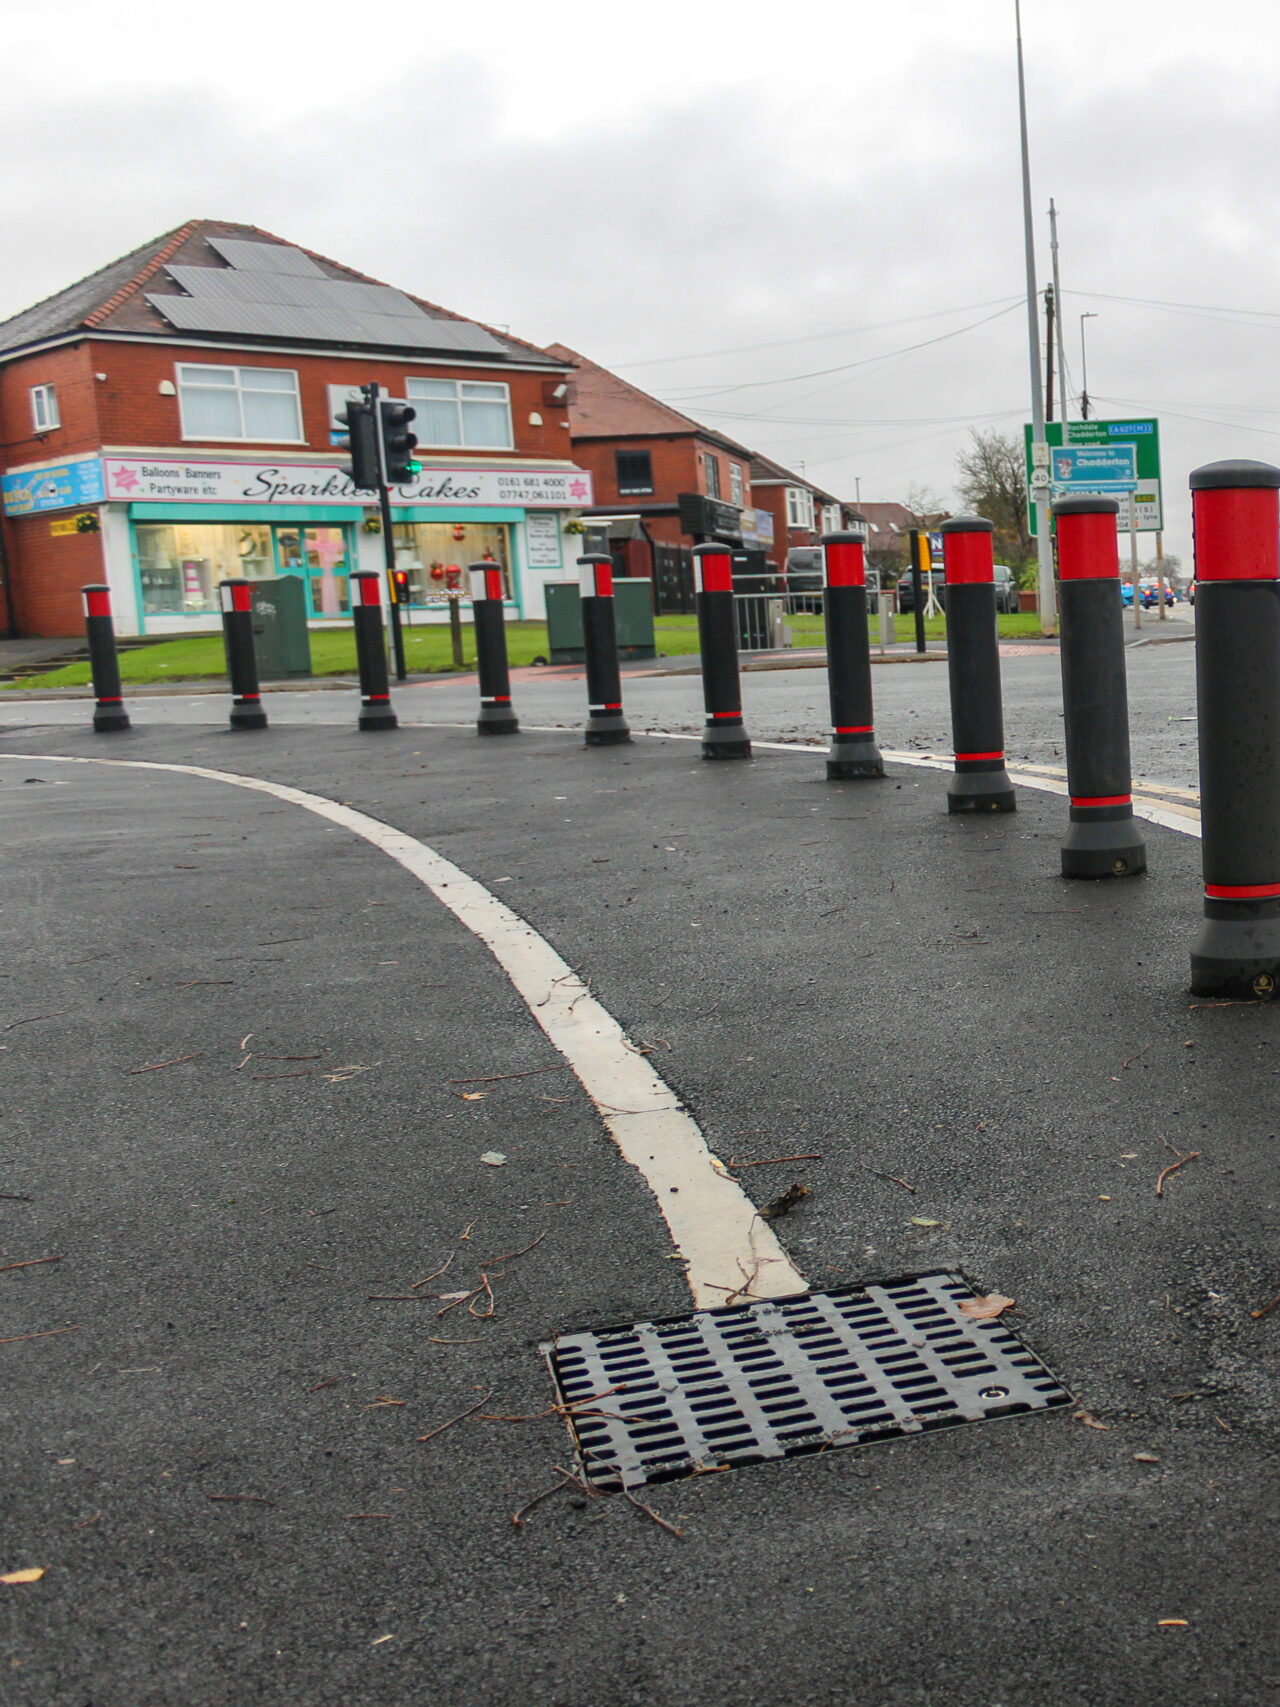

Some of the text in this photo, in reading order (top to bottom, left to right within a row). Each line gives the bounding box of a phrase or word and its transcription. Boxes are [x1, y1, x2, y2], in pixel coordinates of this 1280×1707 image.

[1076, 458, 1130, 467] Chadderton
[141, 466, 222, 479] Balloons Banners
[497, 477, 566, 487] 0161 681 4000
[149, 483, 218, 497] Partyware etc
[499, 490, 530, 499] 07747
